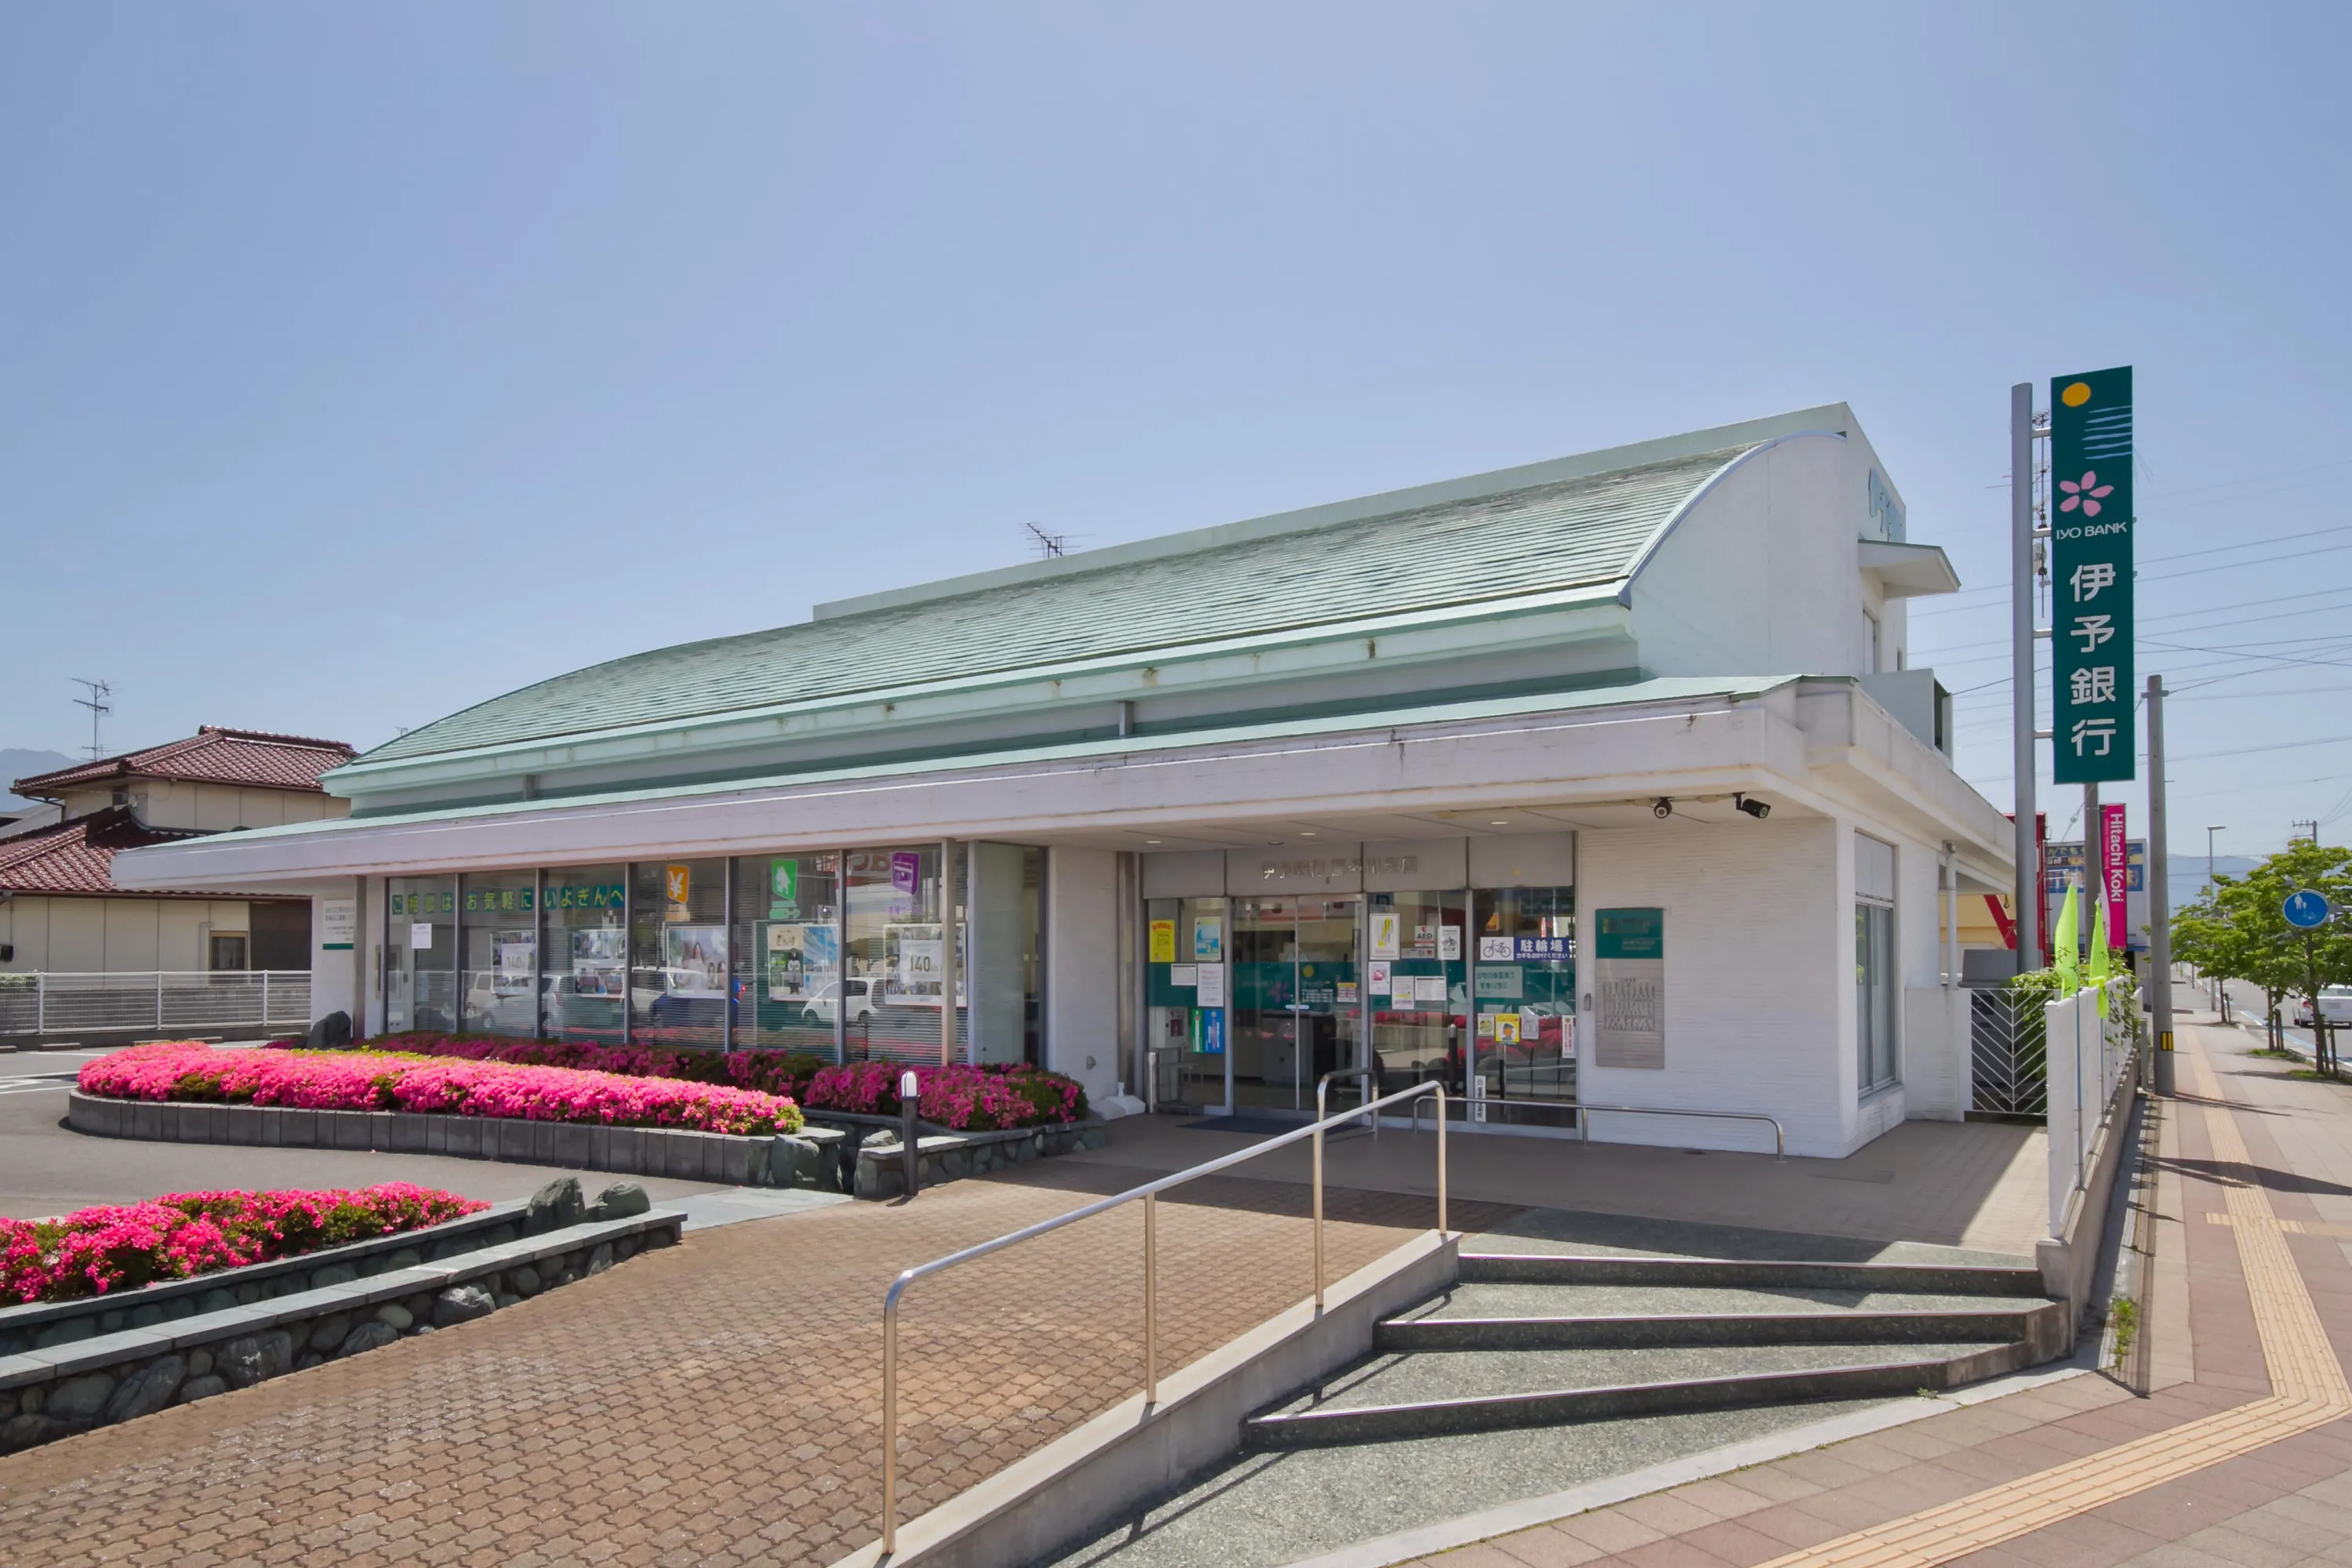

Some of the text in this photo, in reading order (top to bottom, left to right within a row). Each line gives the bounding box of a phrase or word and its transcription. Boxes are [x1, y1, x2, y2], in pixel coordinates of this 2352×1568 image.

[2056, 521, 2127, 540] IYO BANK
[2070, 563, 2116, 757] 伊予銀行
[2111, 813, 2124, 902] Hitachi Koki
[545, 887, 624, 908] いよぎんへ
[1520, 939, 1563, 953] 駐輪場
